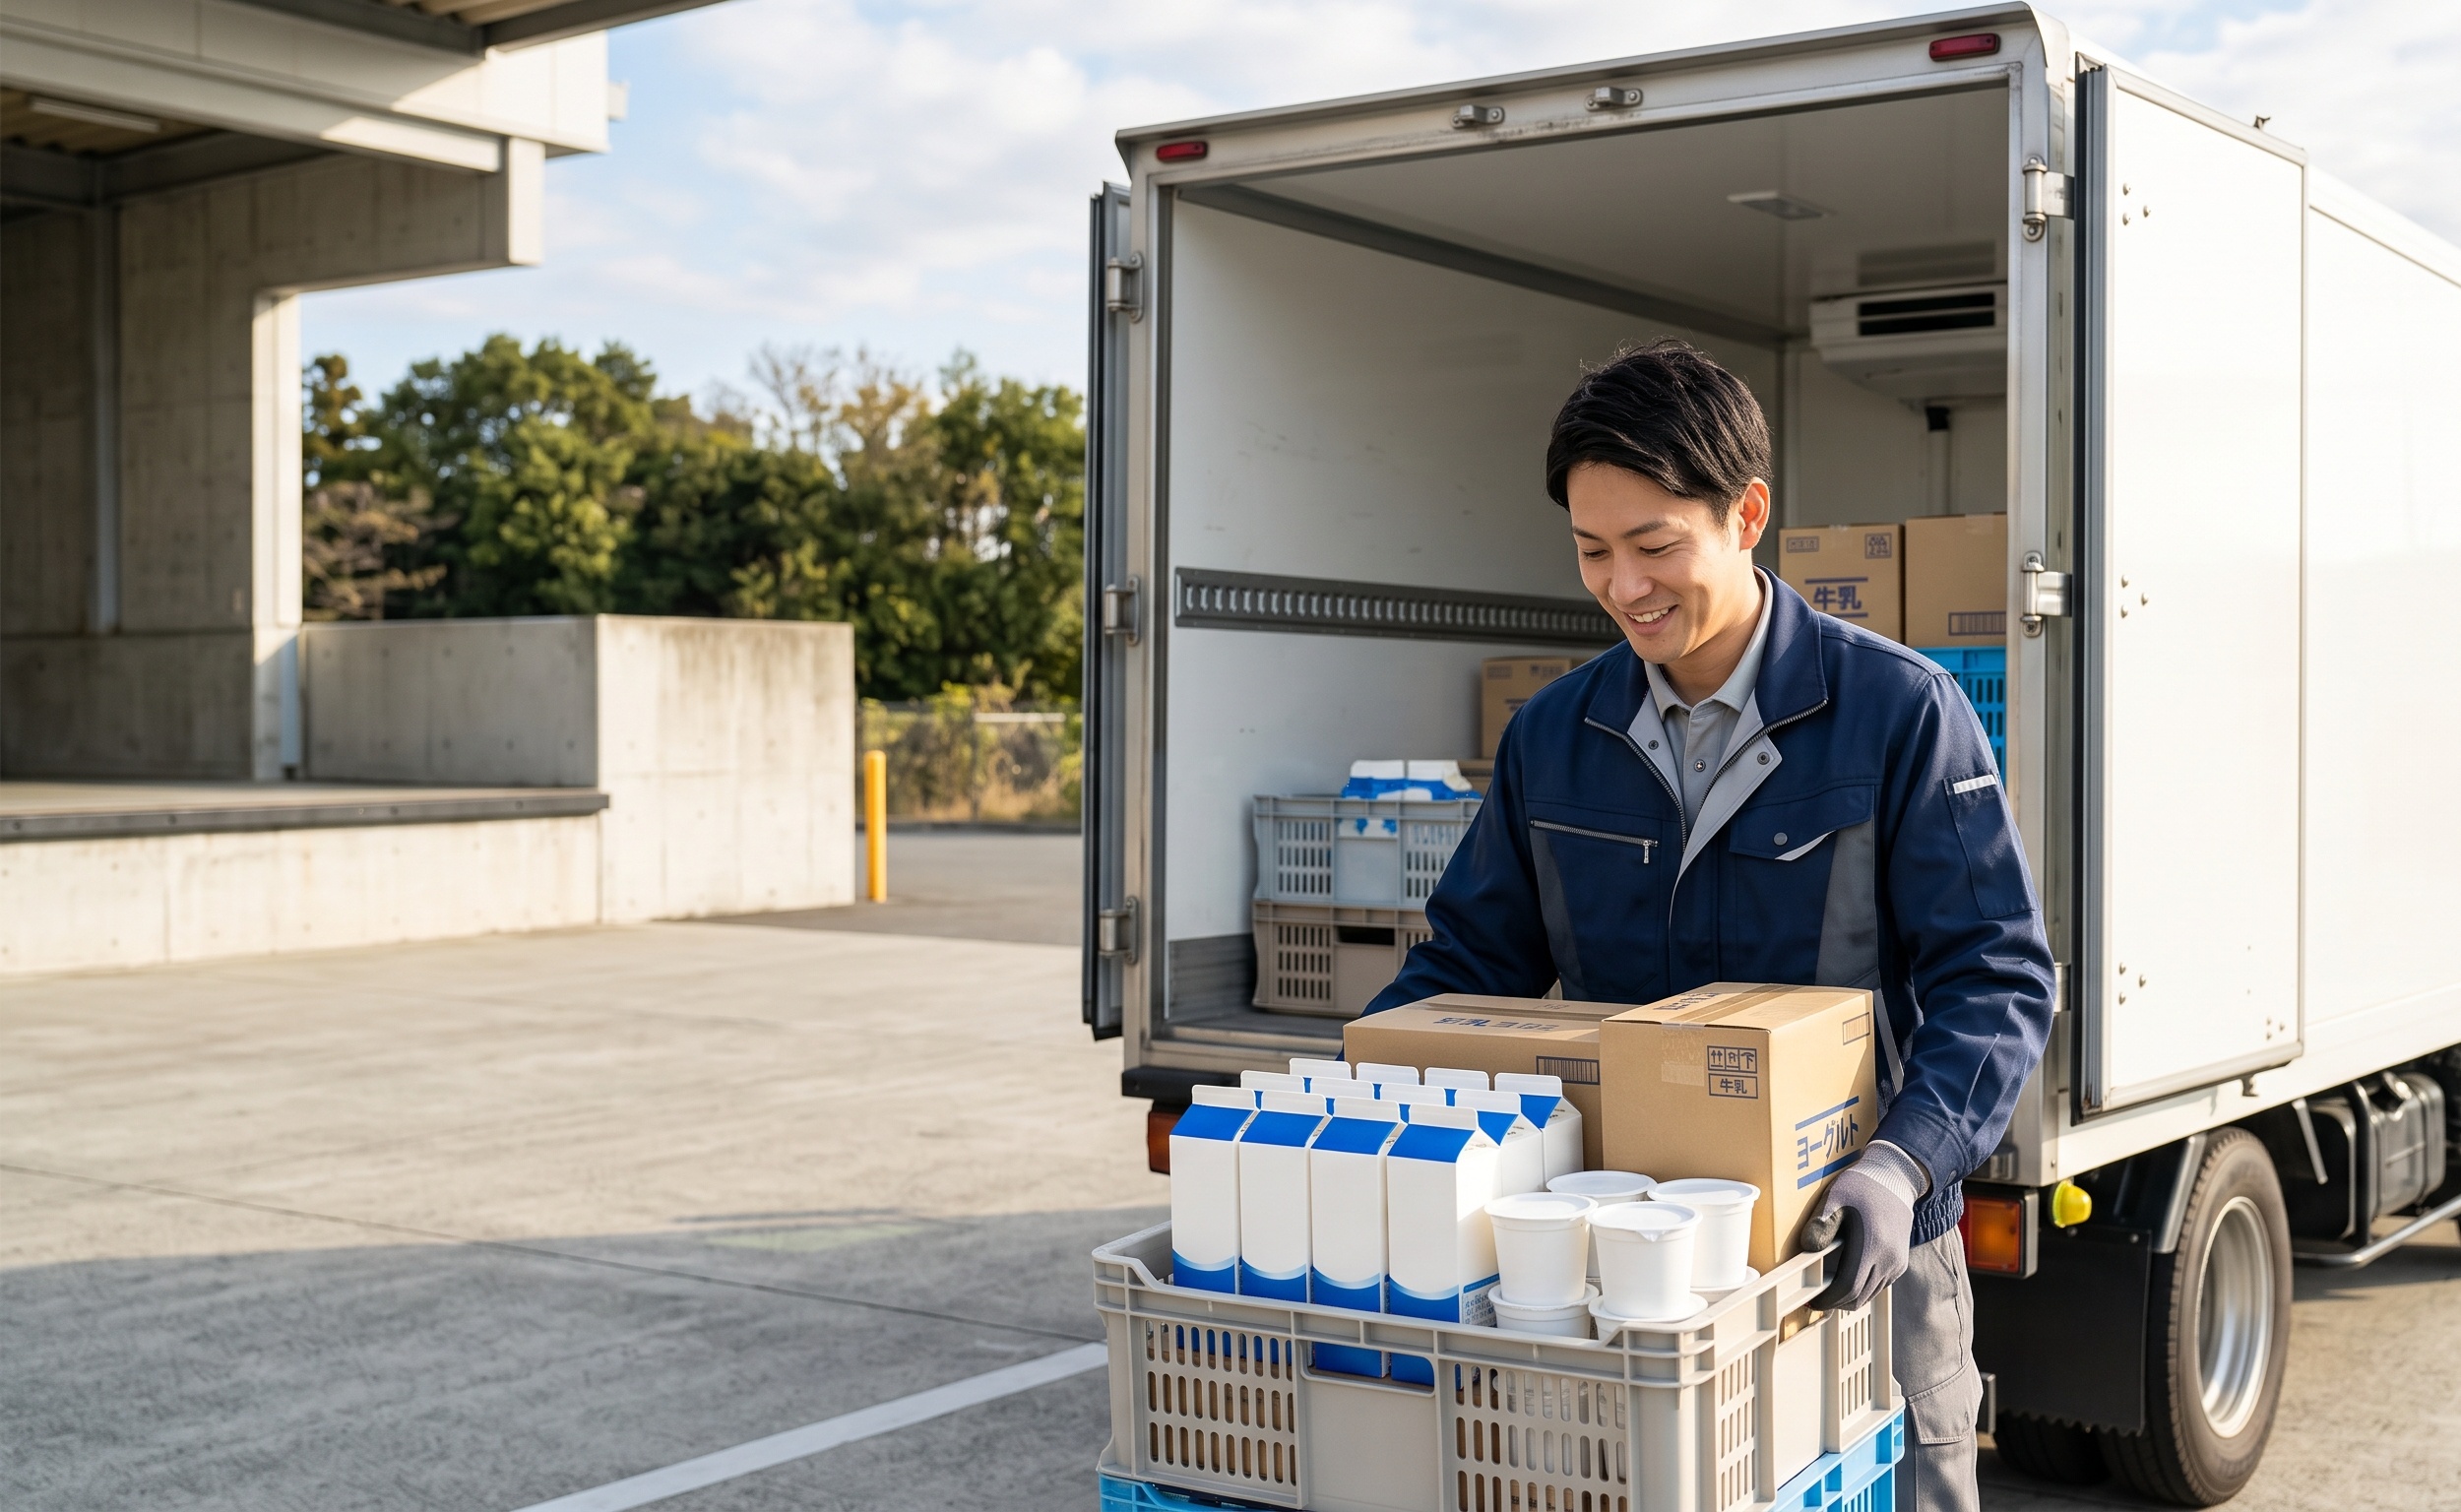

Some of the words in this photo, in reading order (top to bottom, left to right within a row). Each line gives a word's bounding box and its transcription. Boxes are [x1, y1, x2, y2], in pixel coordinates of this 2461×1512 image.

[1813, 585, 1862, 610] 牛乳
[1720, 1078, 1747, 1094] 牛乳
[1797, 1113, 1859, 1170] ヨーグルト
